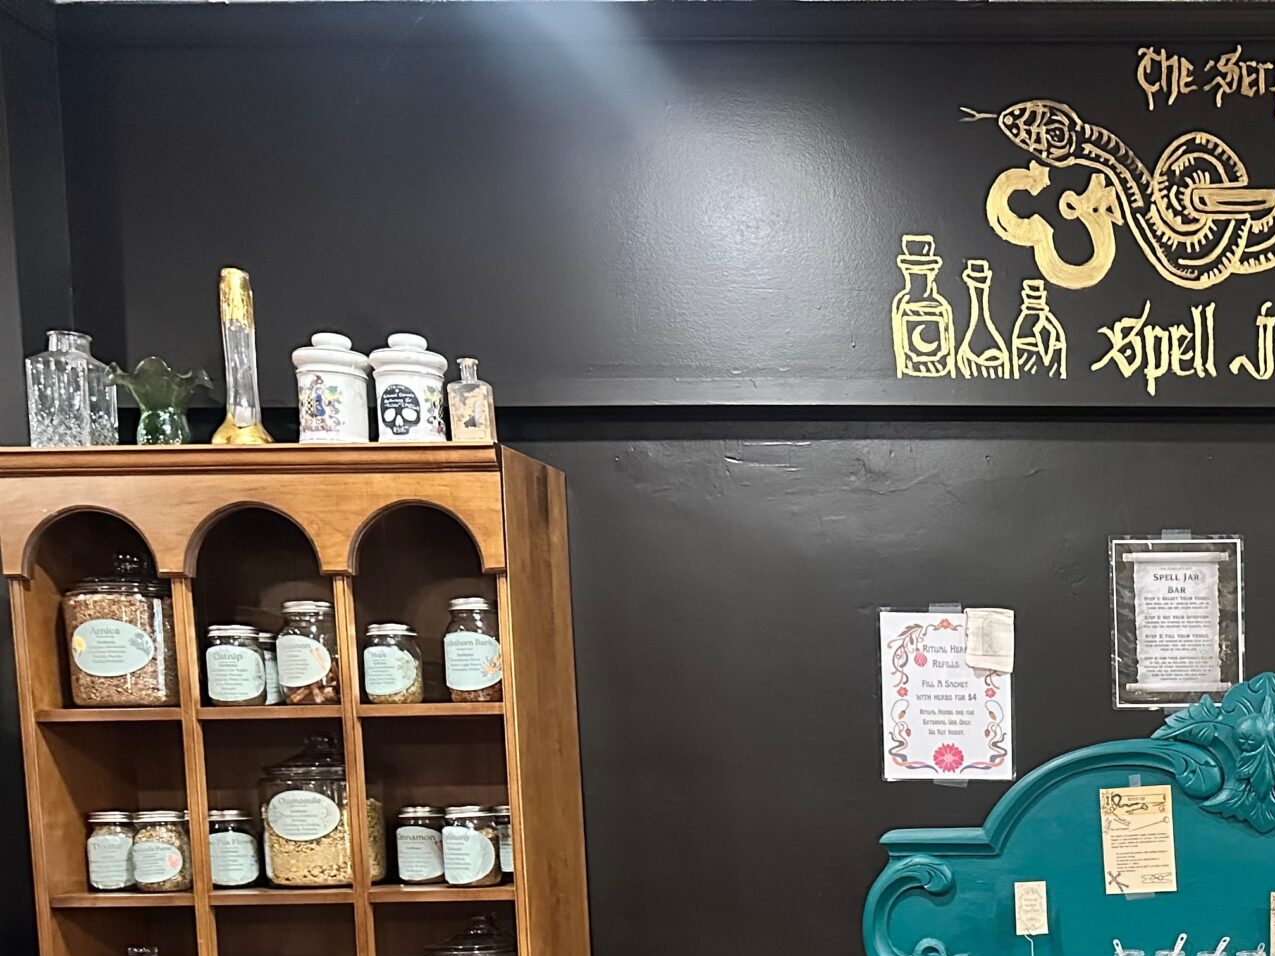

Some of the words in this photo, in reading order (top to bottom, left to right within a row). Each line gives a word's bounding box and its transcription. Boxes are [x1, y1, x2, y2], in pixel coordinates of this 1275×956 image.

[1137, 45, 1198, 111] The
[1091, 300, 1217, 397] Spell
[1153, 573, 1180, 582] SPELL
[1183, 572, 1200, 583] JAR
[1167, 586, 1186, 594] BAR
[922, 644, 948, 653] RITUAL
[213, 652, 243, 662] Catnip
[932, 659, 960, 669] REFILLS
[921, 680, 935, 688] FILL
[937, 680, 943, 688] A
[944, 680, 968, 689] SACHET
[967, 693, 977, 702] $4
